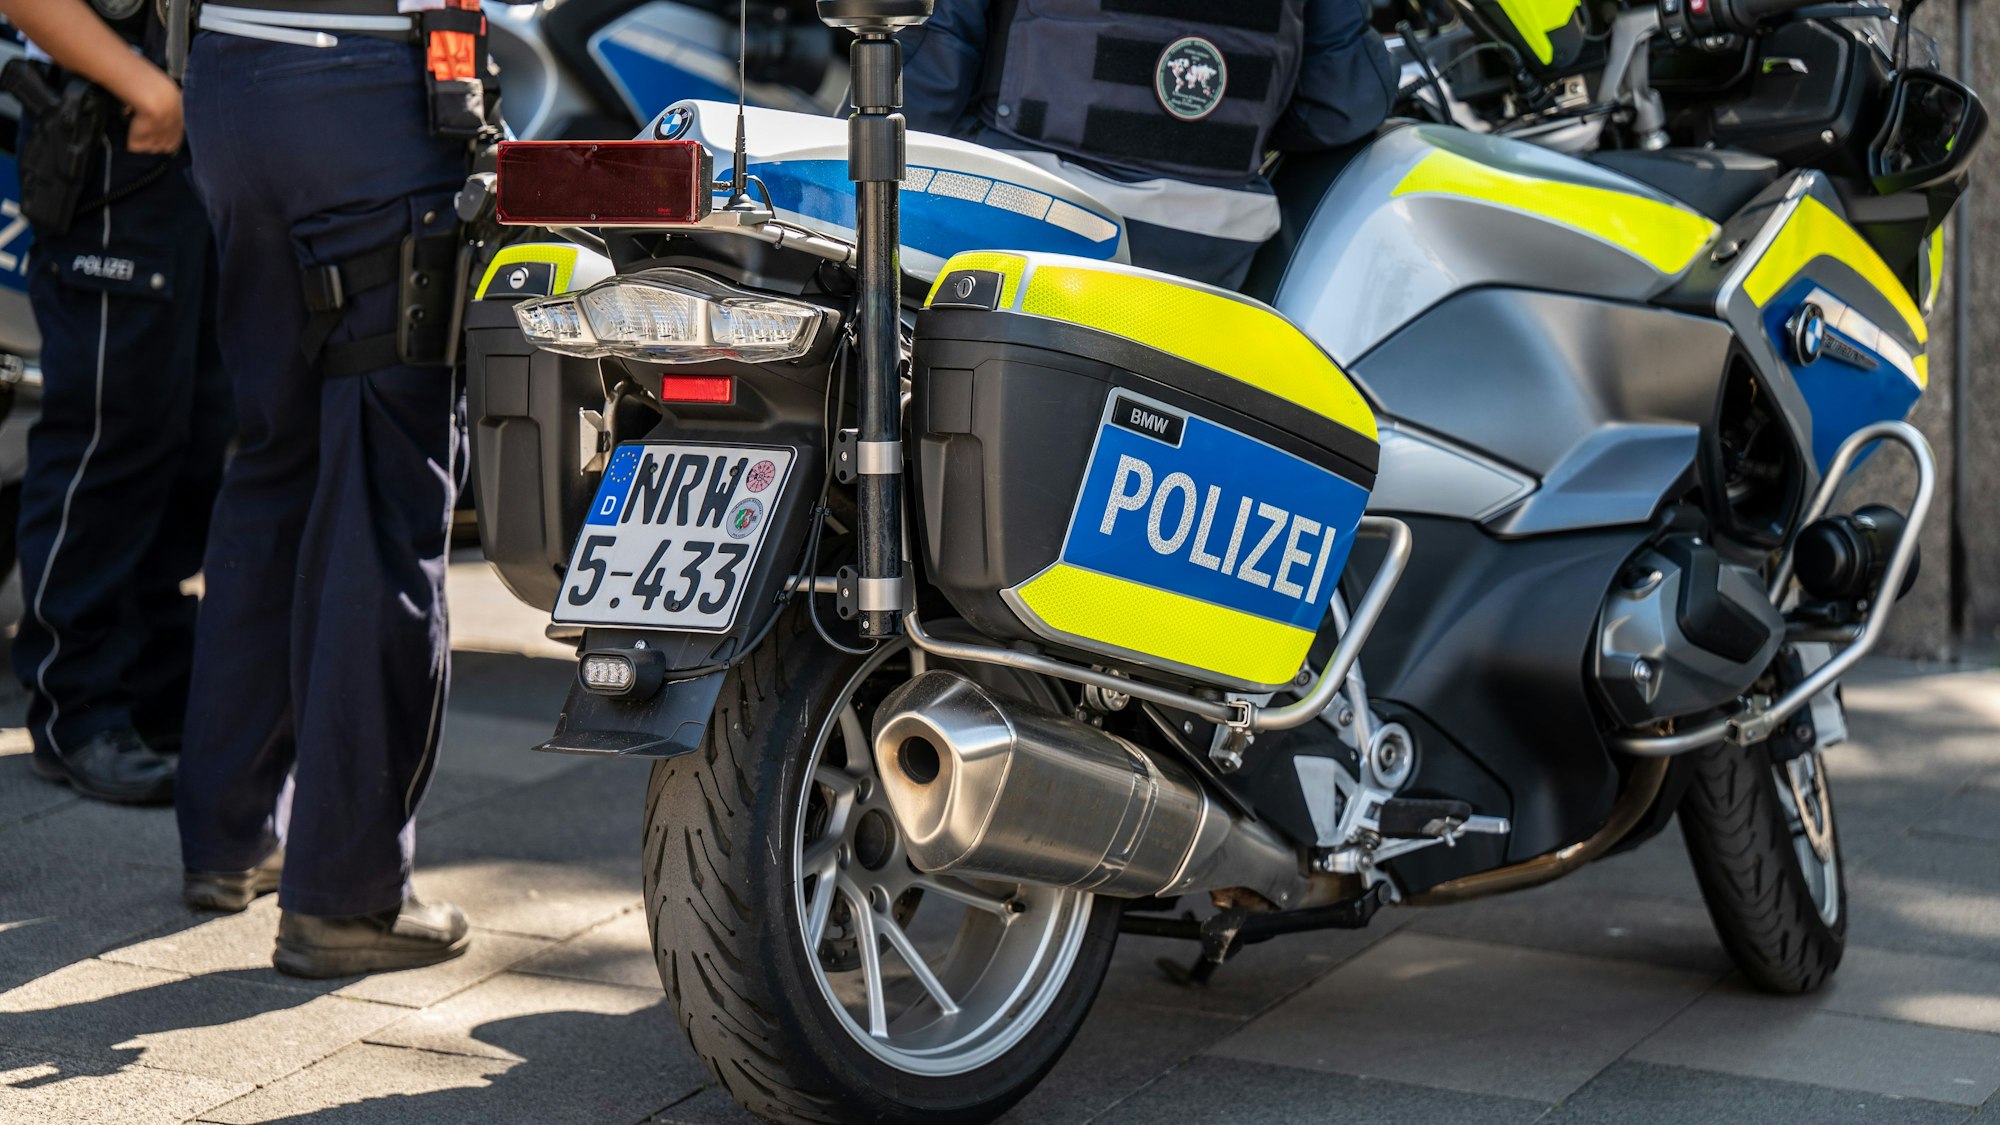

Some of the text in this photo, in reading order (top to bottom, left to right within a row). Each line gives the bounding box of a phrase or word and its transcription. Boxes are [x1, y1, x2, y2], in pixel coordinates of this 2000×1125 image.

[1130, 408, 1170, 434] BMW
[600, 495, 617, 516] D
[621, 453, 749, 529] NRW
[1100, 453, 1336, 605] POLIZEI
[567, 535, 750, 615] 5-433
